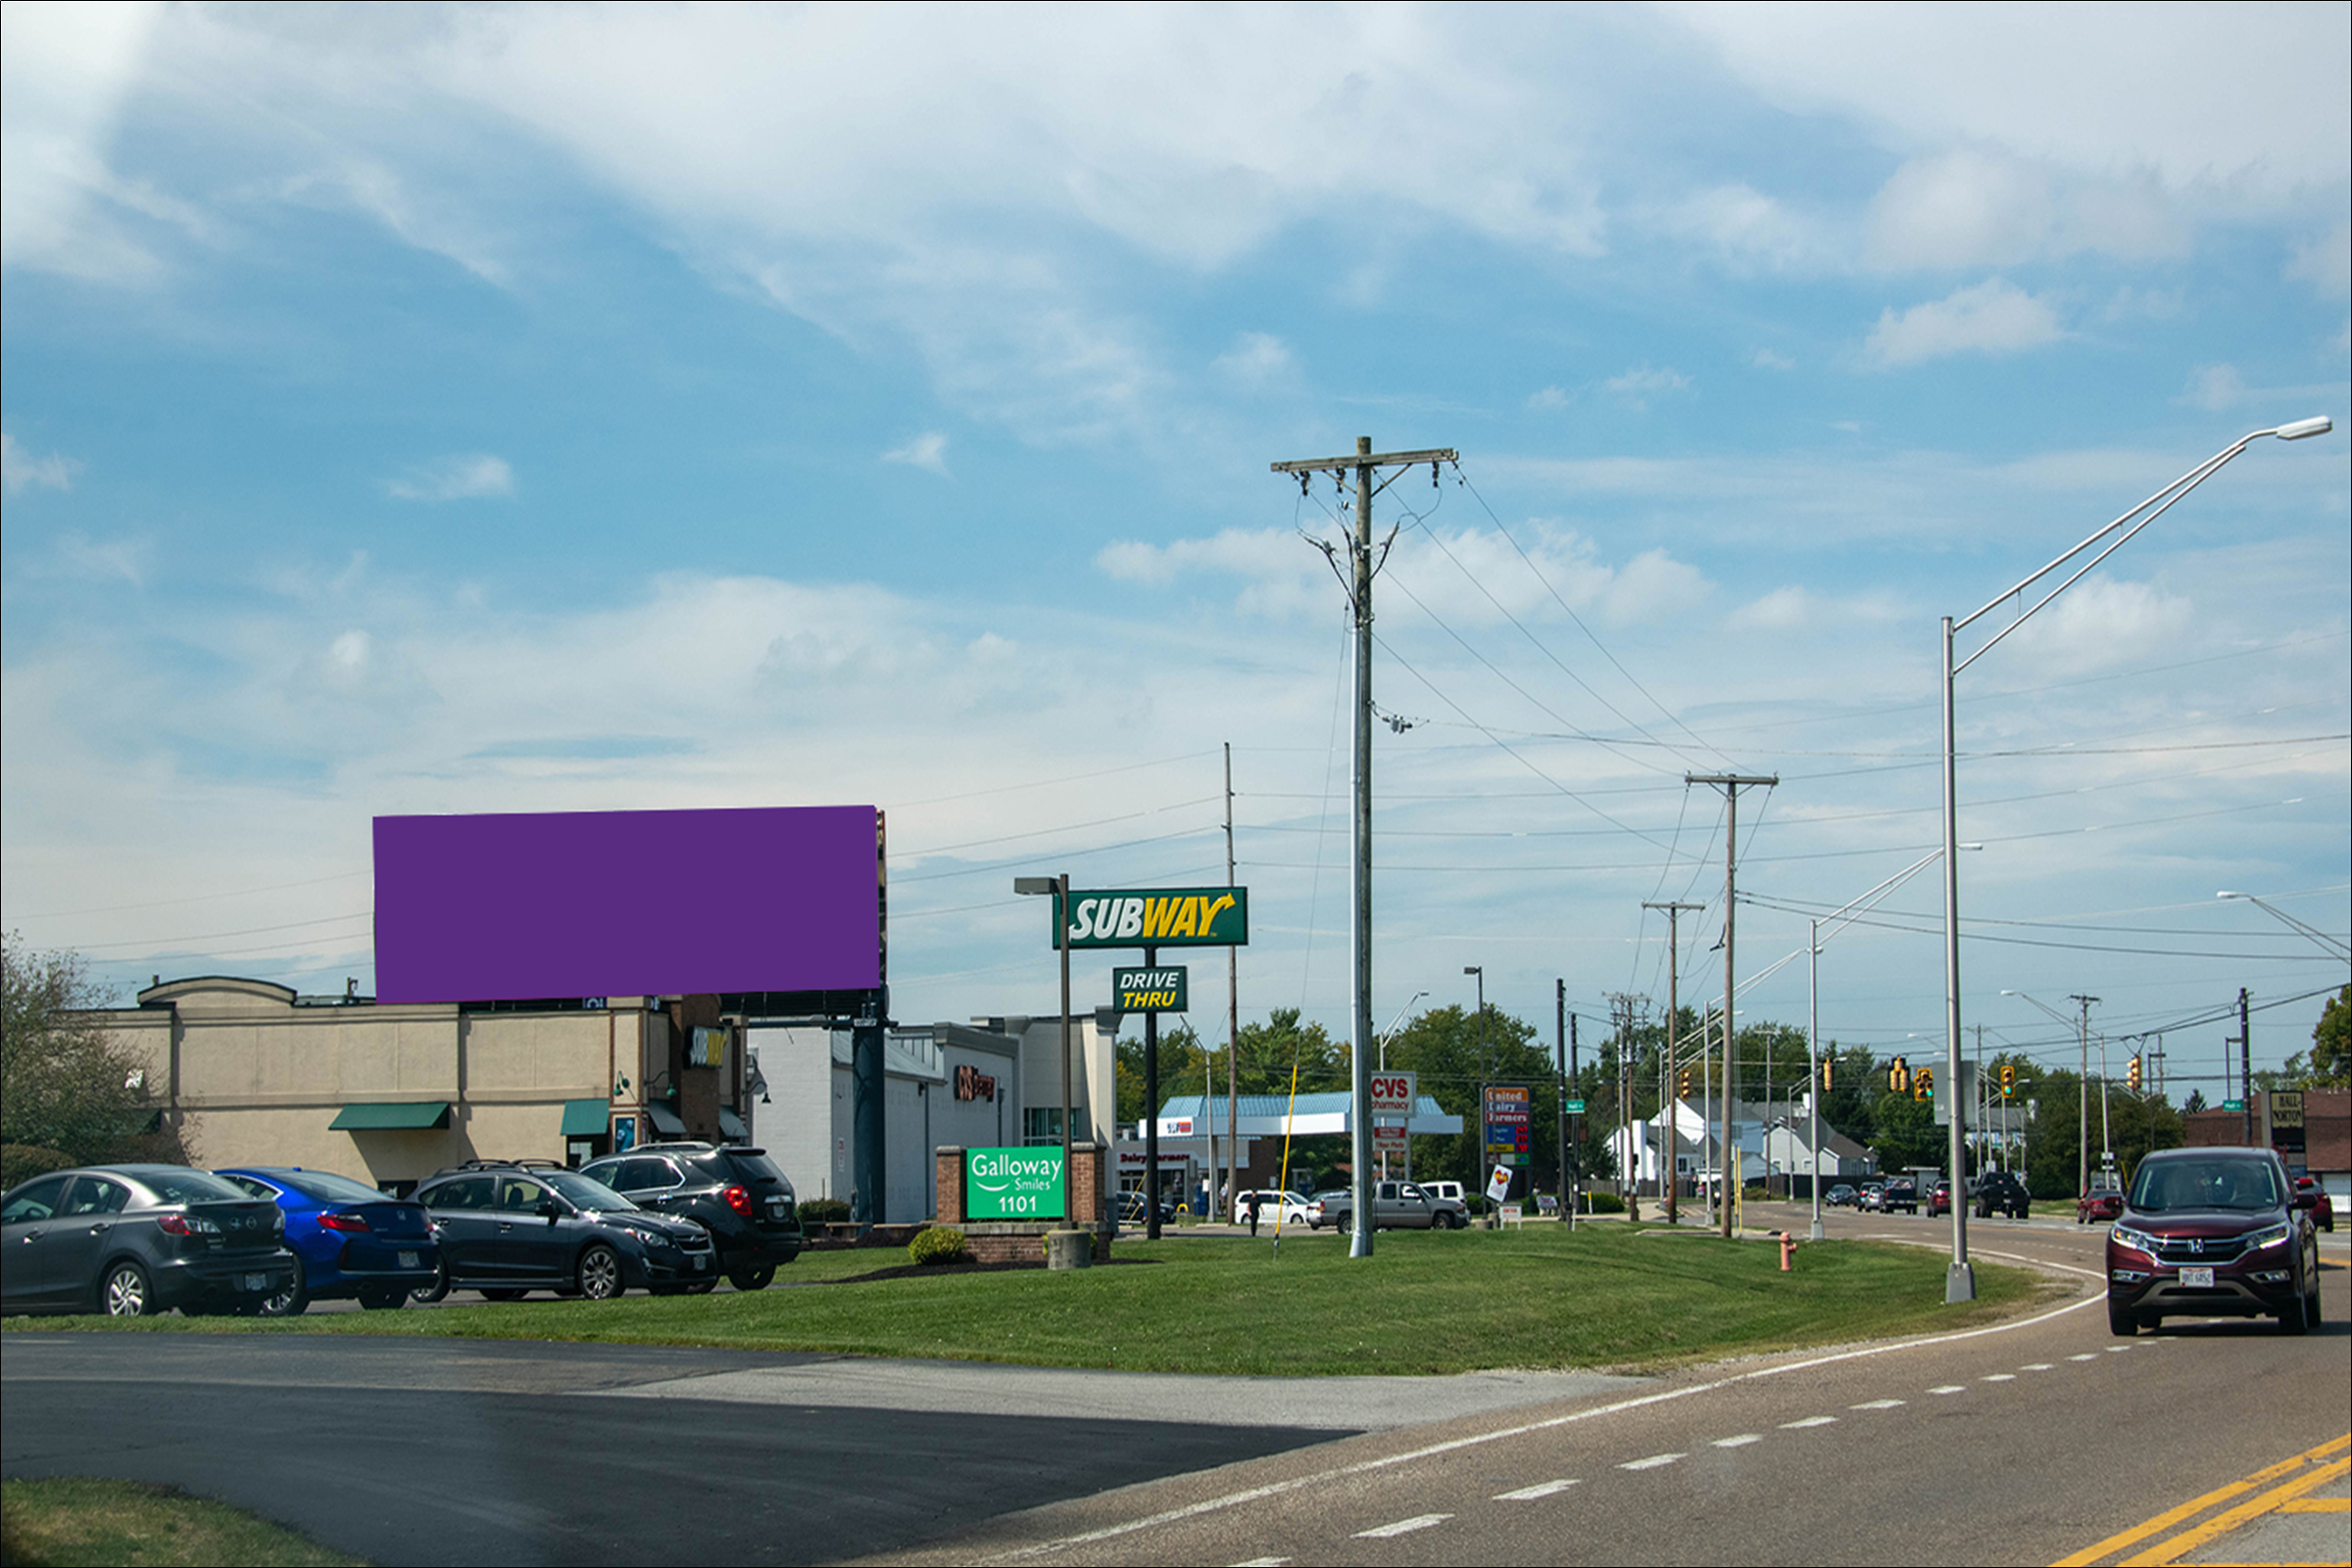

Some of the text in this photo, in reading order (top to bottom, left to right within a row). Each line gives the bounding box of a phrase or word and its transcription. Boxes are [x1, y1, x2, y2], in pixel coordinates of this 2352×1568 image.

[1068, 892, 1236, 942] SUBWAY
[1119, 972, 1179, 989] DRIVE
[1122, 991, 1176, 1008] THRU
[1371, 1078, 1408, 1099] CVS
[1488, 1091, 1523, 1101] United
[1120, 1152, 1147, 1164] Dairy
[971, 1153, 1062, 1182] Galloway
[1014, 1177, 1051, 1191] Smiles
[999, 1196, 1037, 1212] 1101
